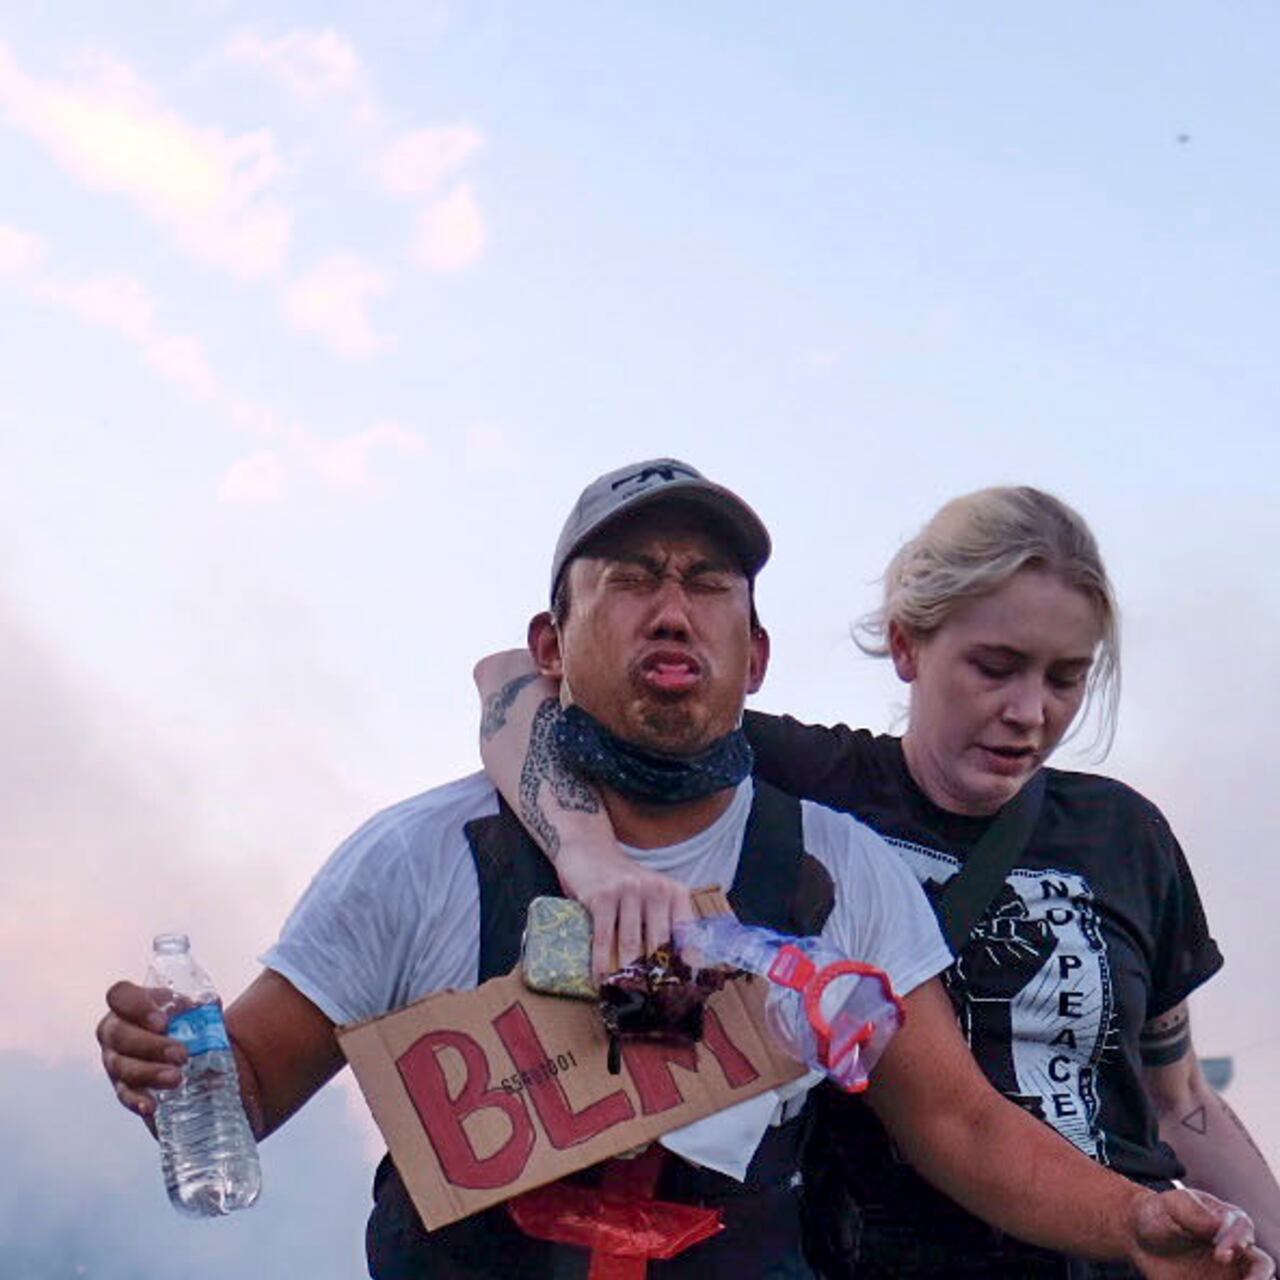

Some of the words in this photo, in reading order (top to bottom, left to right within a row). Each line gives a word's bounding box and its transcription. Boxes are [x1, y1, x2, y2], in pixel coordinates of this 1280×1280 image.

[1040, 880, 1075, 926] NO
[395, 1001, 760, 1190] BLM
[1048, 955, 1084, 1119] PEACE
